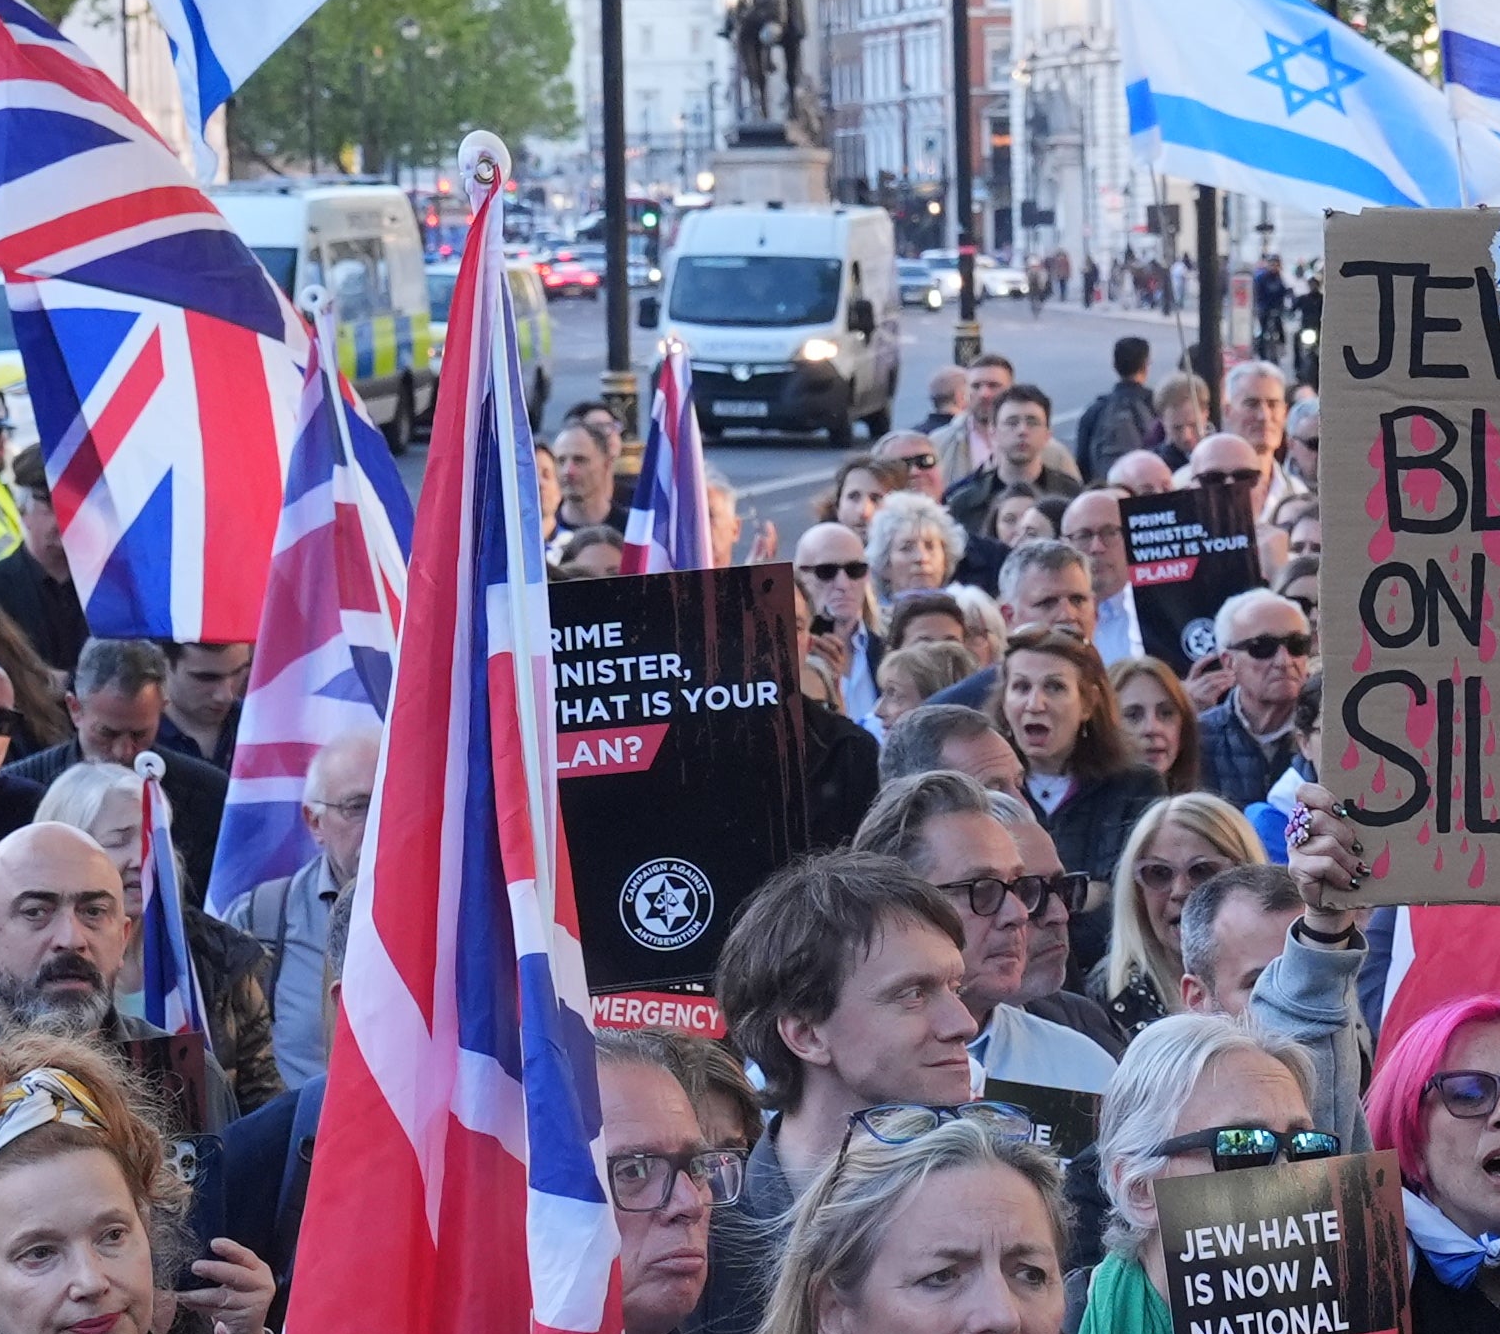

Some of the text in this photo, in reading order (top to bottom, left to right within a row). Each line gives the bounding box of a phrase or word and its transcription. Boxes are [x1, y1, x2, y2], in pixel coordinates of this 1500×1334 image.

[1128, 510, 1177, 529] PRIME
[1130, 524, 1208, 546] MINISTER,
[1132, 534, 1249, 562] WHAT IS YOUR
[1135, 562, 1189, 582] PLAN?
[1359, 552, 1486, 651] ON
[550, 622, 623, 652] RIME
[555, 681, 779, 726] HAT IS YOUR
[625, 863, 708, 903] CAMPAIGN AGAINST
[633, 920, 702, 946] ANTISEMITISM
[592, 995, 722, 1030] MERGENCY
[1179, 1210, 1341, 1262] JEW-HATE
[1184, 1257, 1333, 1308] IS NOW A
